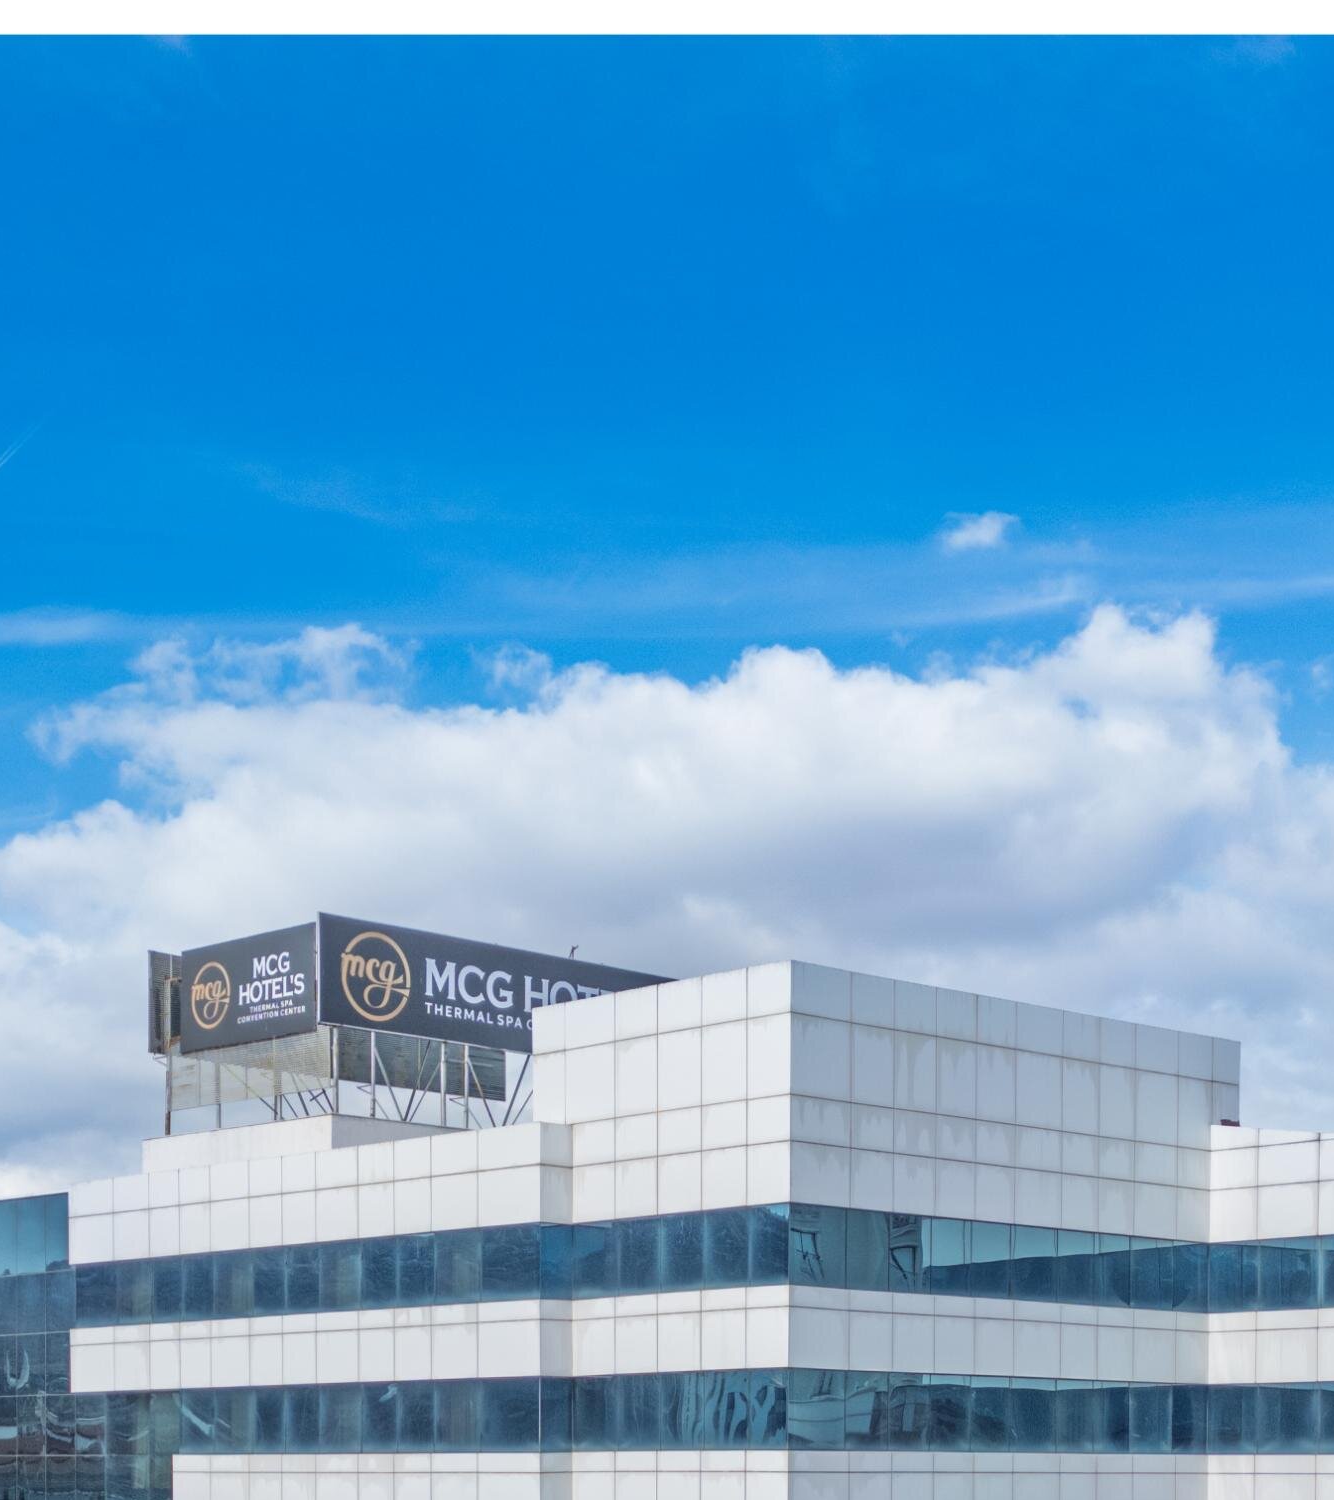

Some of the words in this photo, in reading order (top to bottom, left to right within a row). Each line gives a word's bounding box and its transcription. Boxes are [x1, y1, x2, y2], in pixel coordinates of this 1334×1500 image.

[252, 951, 290, 979] MCG
[238, 973, 305, 1006] HOTEL'S
[424, 957, 515, 1010] MCG
[237, 1010, 279, 1024] CONVENTION
[280, 1005, 306, 1016] CENTER
[249, 1001, 279, 1013] THERMAL
[280, 999, 293, 1007] SPA
[425, 1002, 494, 1025] THERMAL
[497, 1013, 523, 1031] SPA
